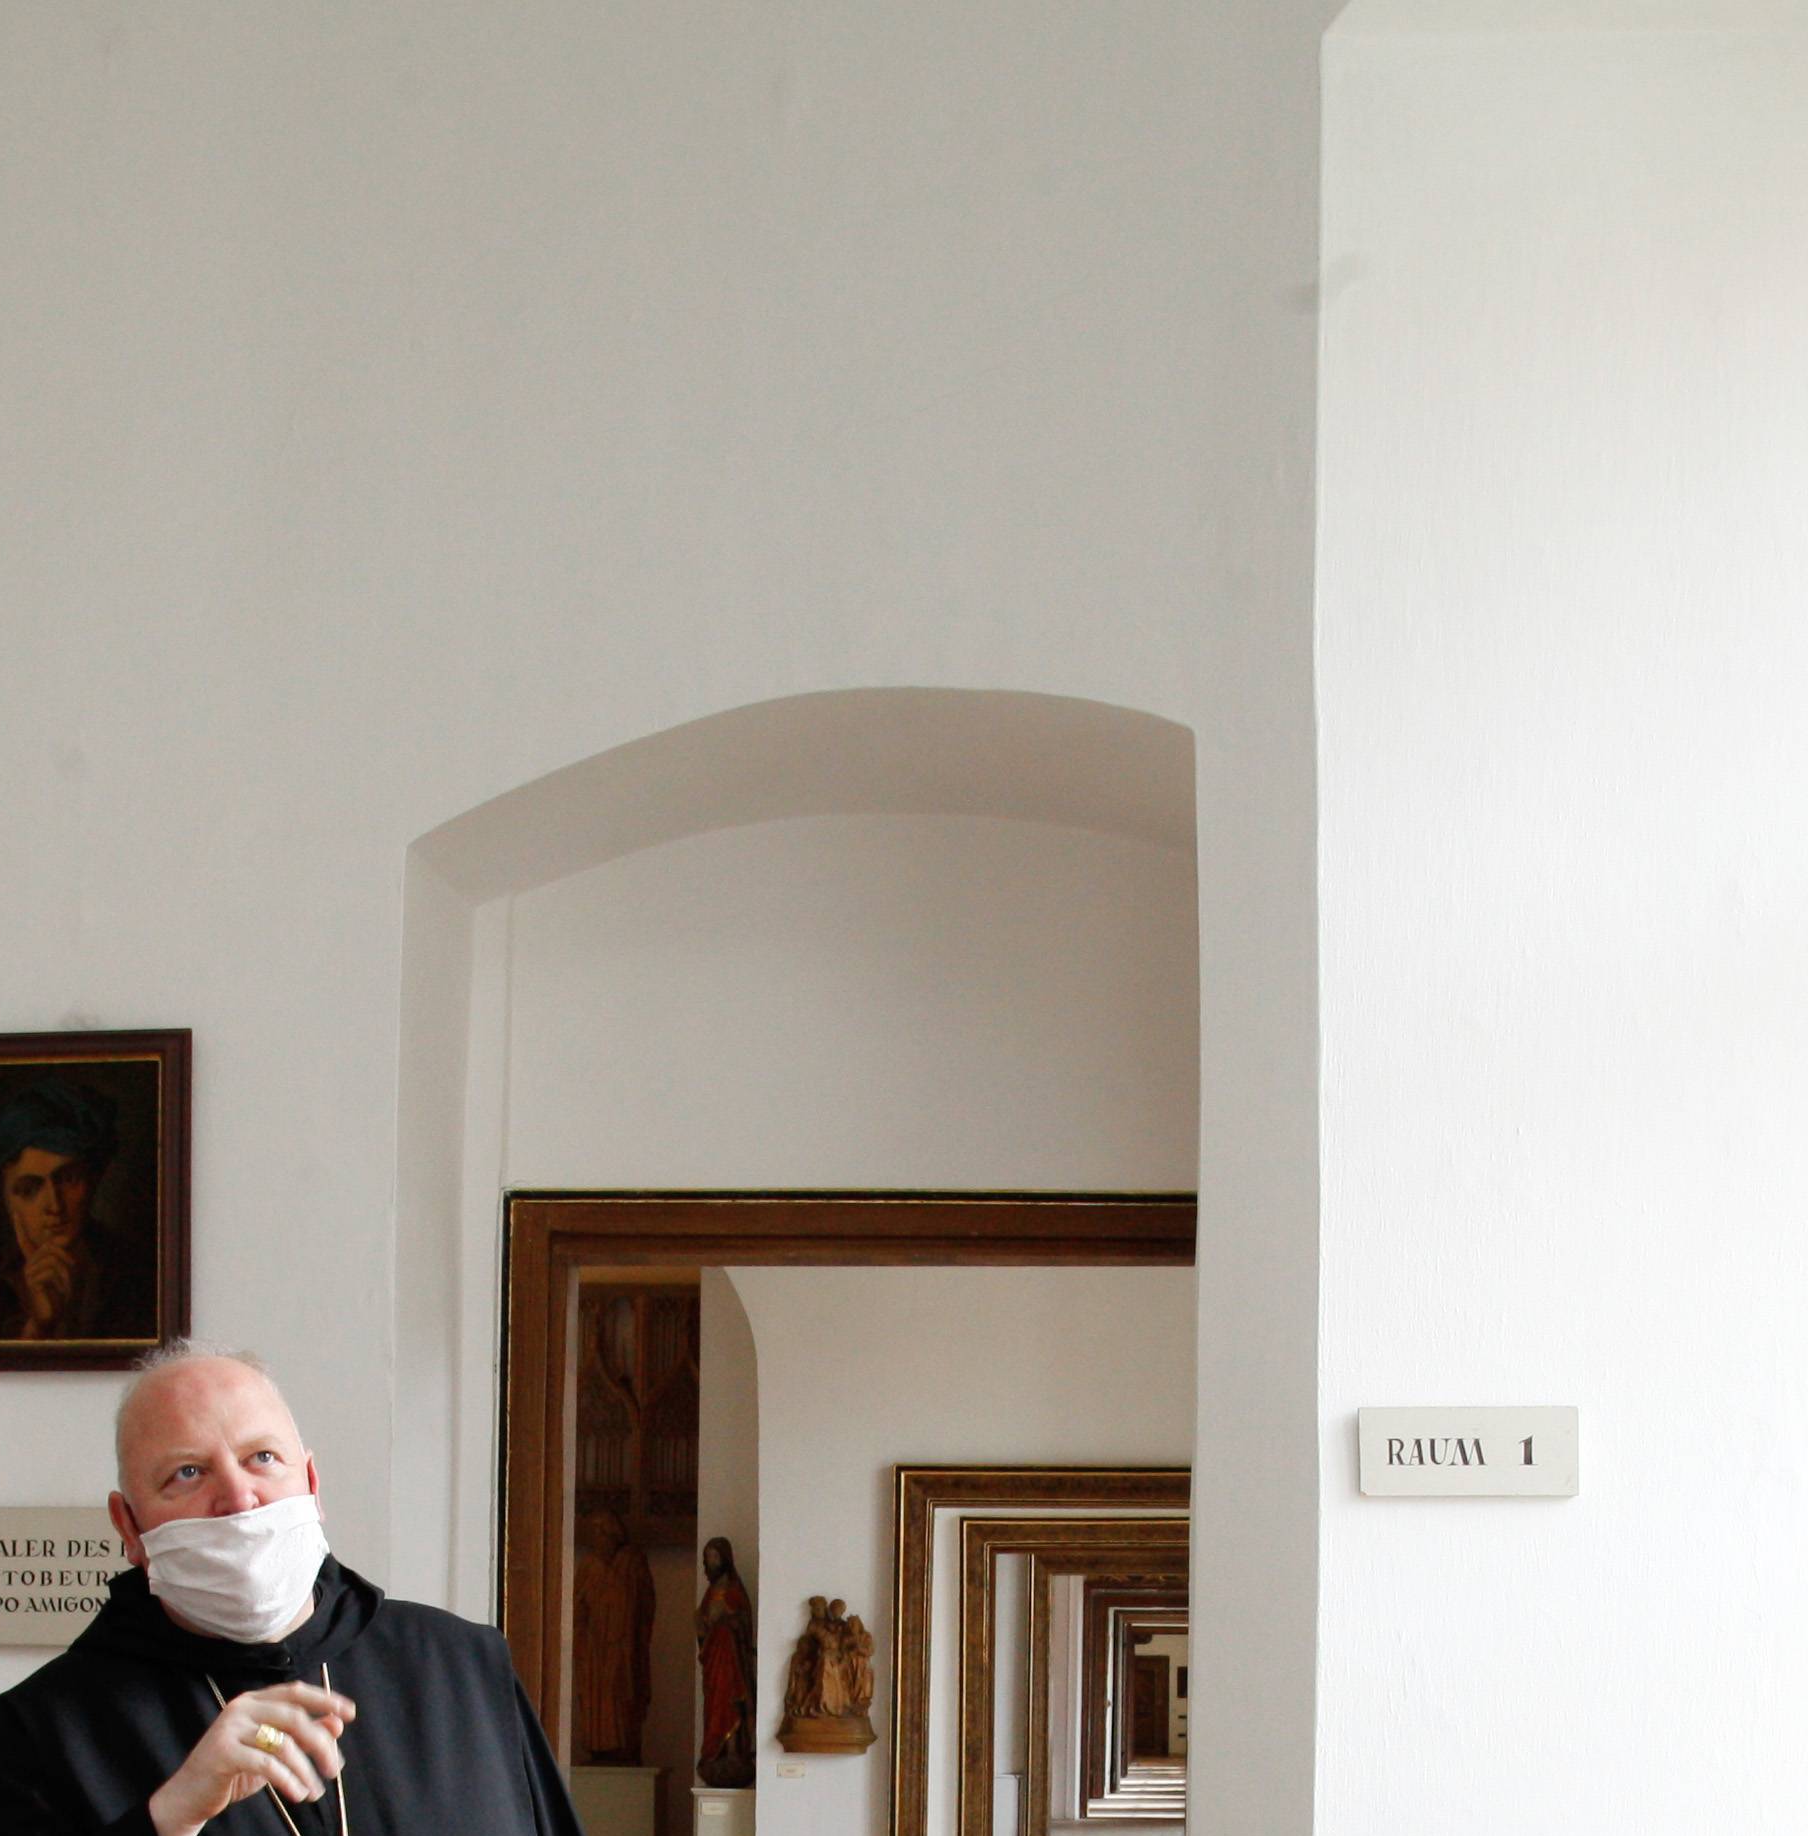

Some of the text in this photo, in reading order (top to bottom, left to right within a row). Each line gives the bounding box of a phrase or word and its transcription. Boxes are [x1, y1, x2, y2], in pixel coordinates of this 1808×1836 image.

[1386, 1434, 1539, 1467] RAUM 1
[67, 1539, 111, 1558] DES
